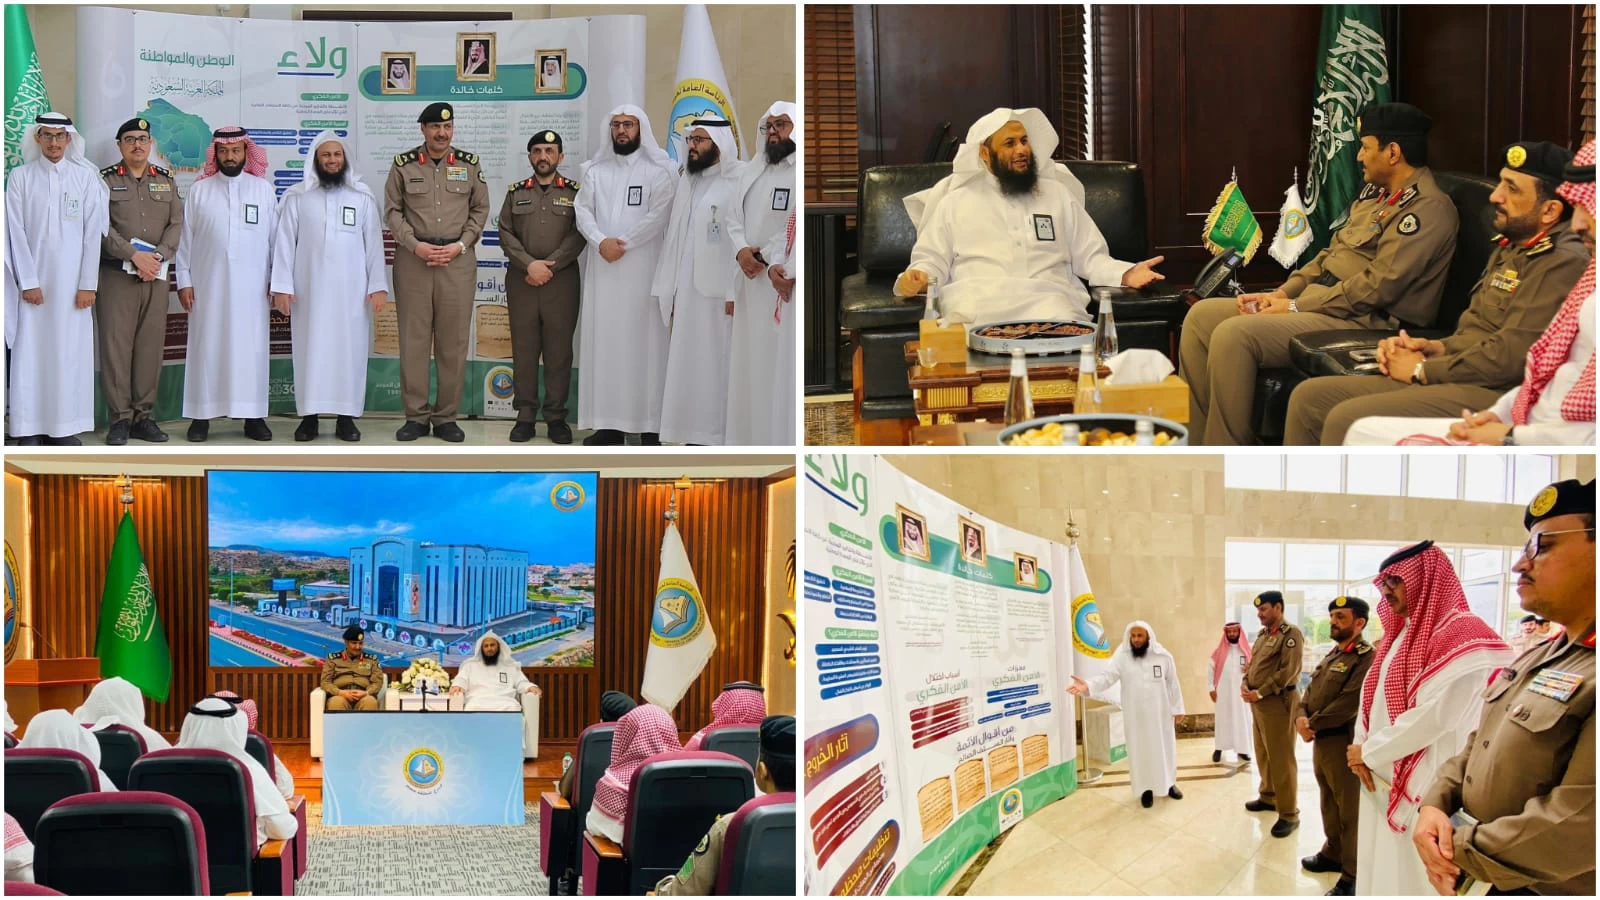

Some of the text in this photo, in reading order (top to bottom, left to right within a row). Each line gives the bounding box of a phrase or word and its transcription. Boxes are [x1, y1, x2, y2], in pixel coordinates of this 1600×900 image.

[140, 48, 234, 69] الوطن والمواطنة
[277, 36, 347, 79] ولاء
[450, 85, 504, 95] كلمات خالدة
[682, 82, 705, 92] العامة
[705, 85, 726, 107] الرئاسة
[477, 277, 497, 293] أقو
[992, 673, 1022, 688] الفكري
[916, 679, 969, 706] الأمن الفكري
[956, 725, 1015, 752] من أقوال الأئمة
[806, 732, 849, 778] آثار الخروج
[863, 828, 891, 870] تنظيمات
